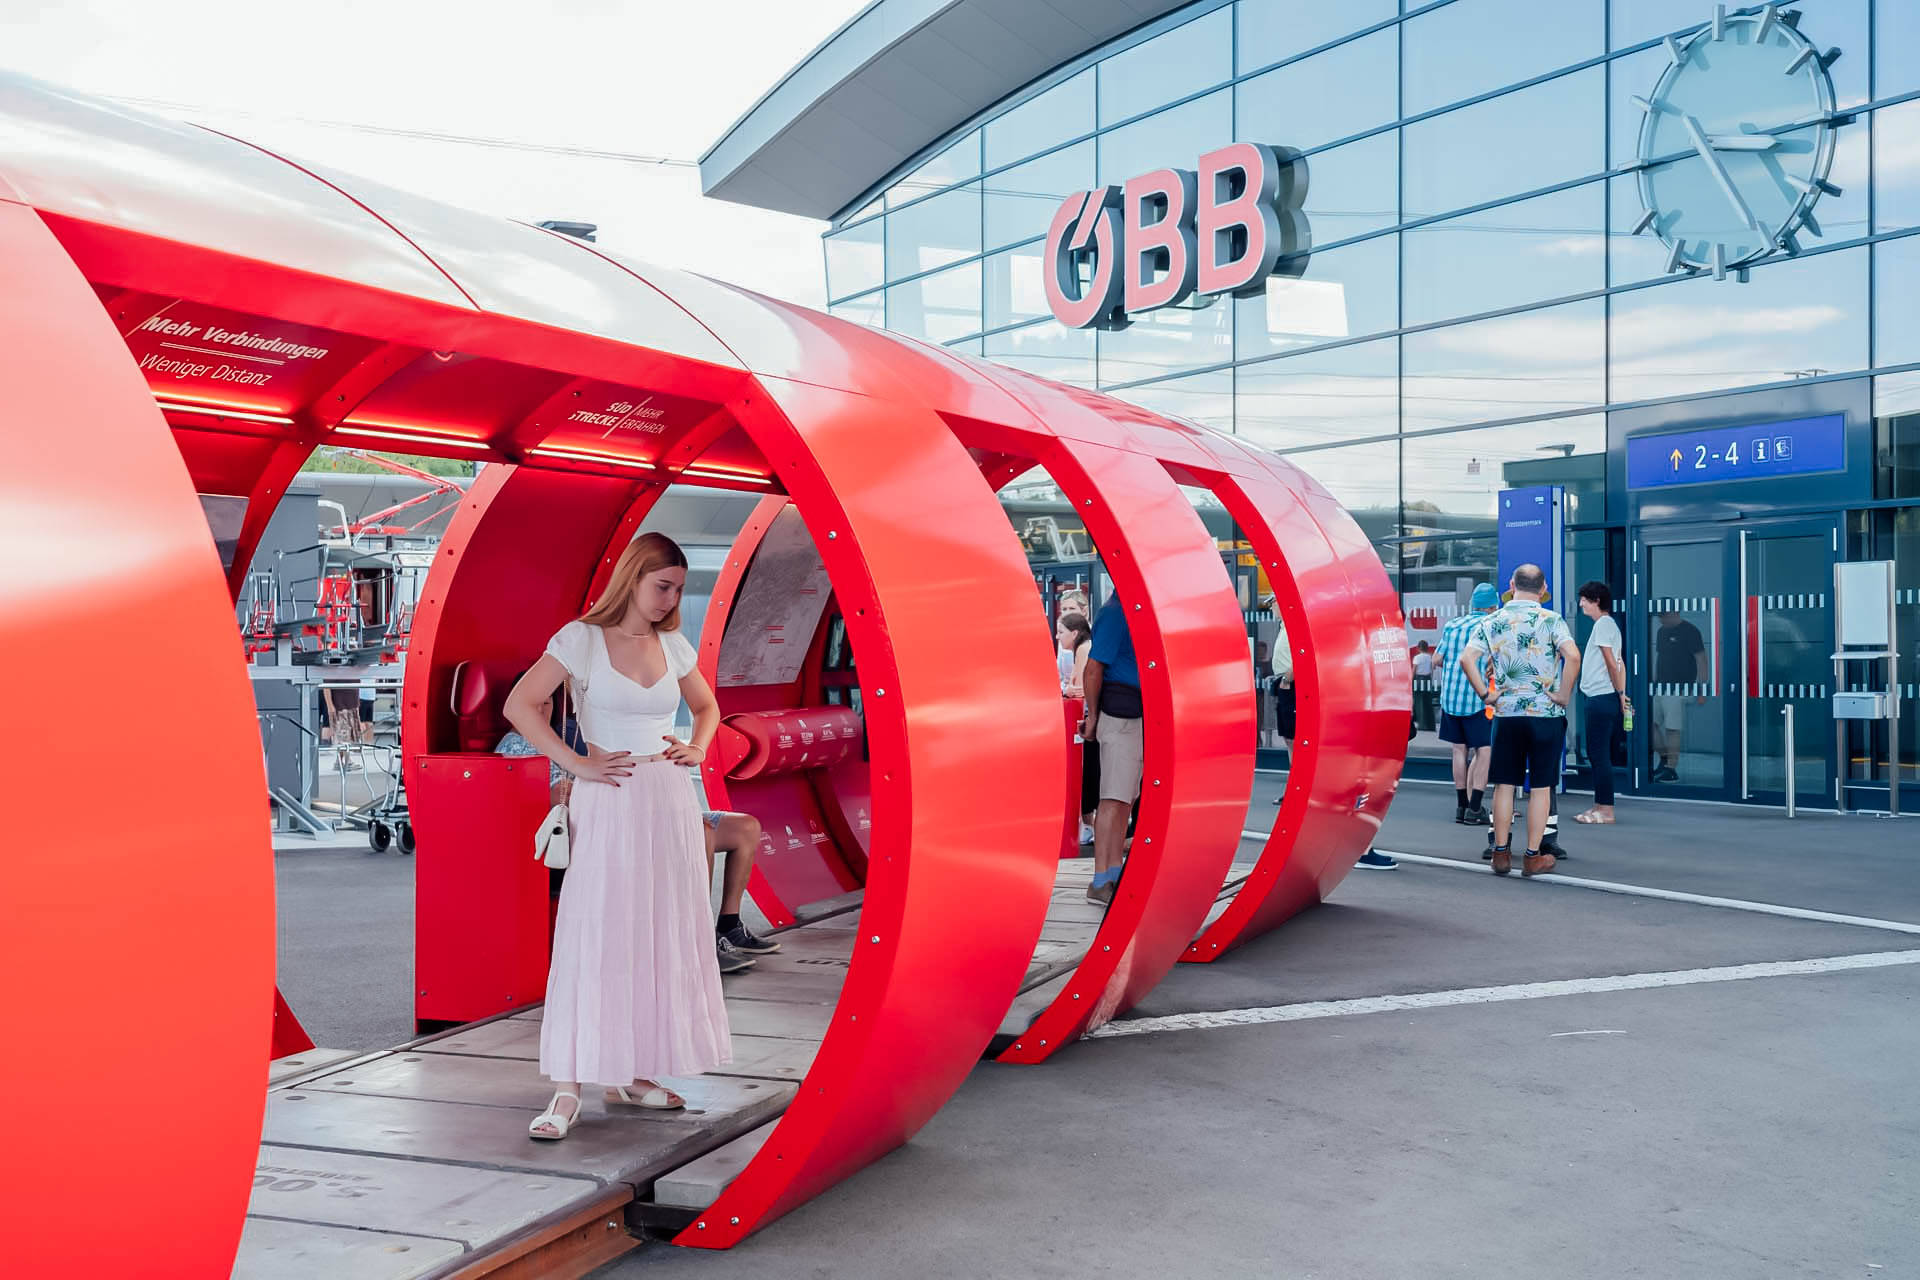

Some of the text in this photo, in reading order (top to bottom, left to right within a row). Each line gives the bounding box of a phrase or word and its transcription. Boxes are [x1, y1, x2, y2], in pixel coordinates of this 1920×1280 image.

[1044, 142, 1270, 329] ÖBB
[140, 316, 329, 360] Mehr Verbindungen
[139, 353, 273, 386] Weniger Distanz
[606, 402, 664, 418] SÜD MEHR
[620, 419, 665, 433] ERFAHREN
